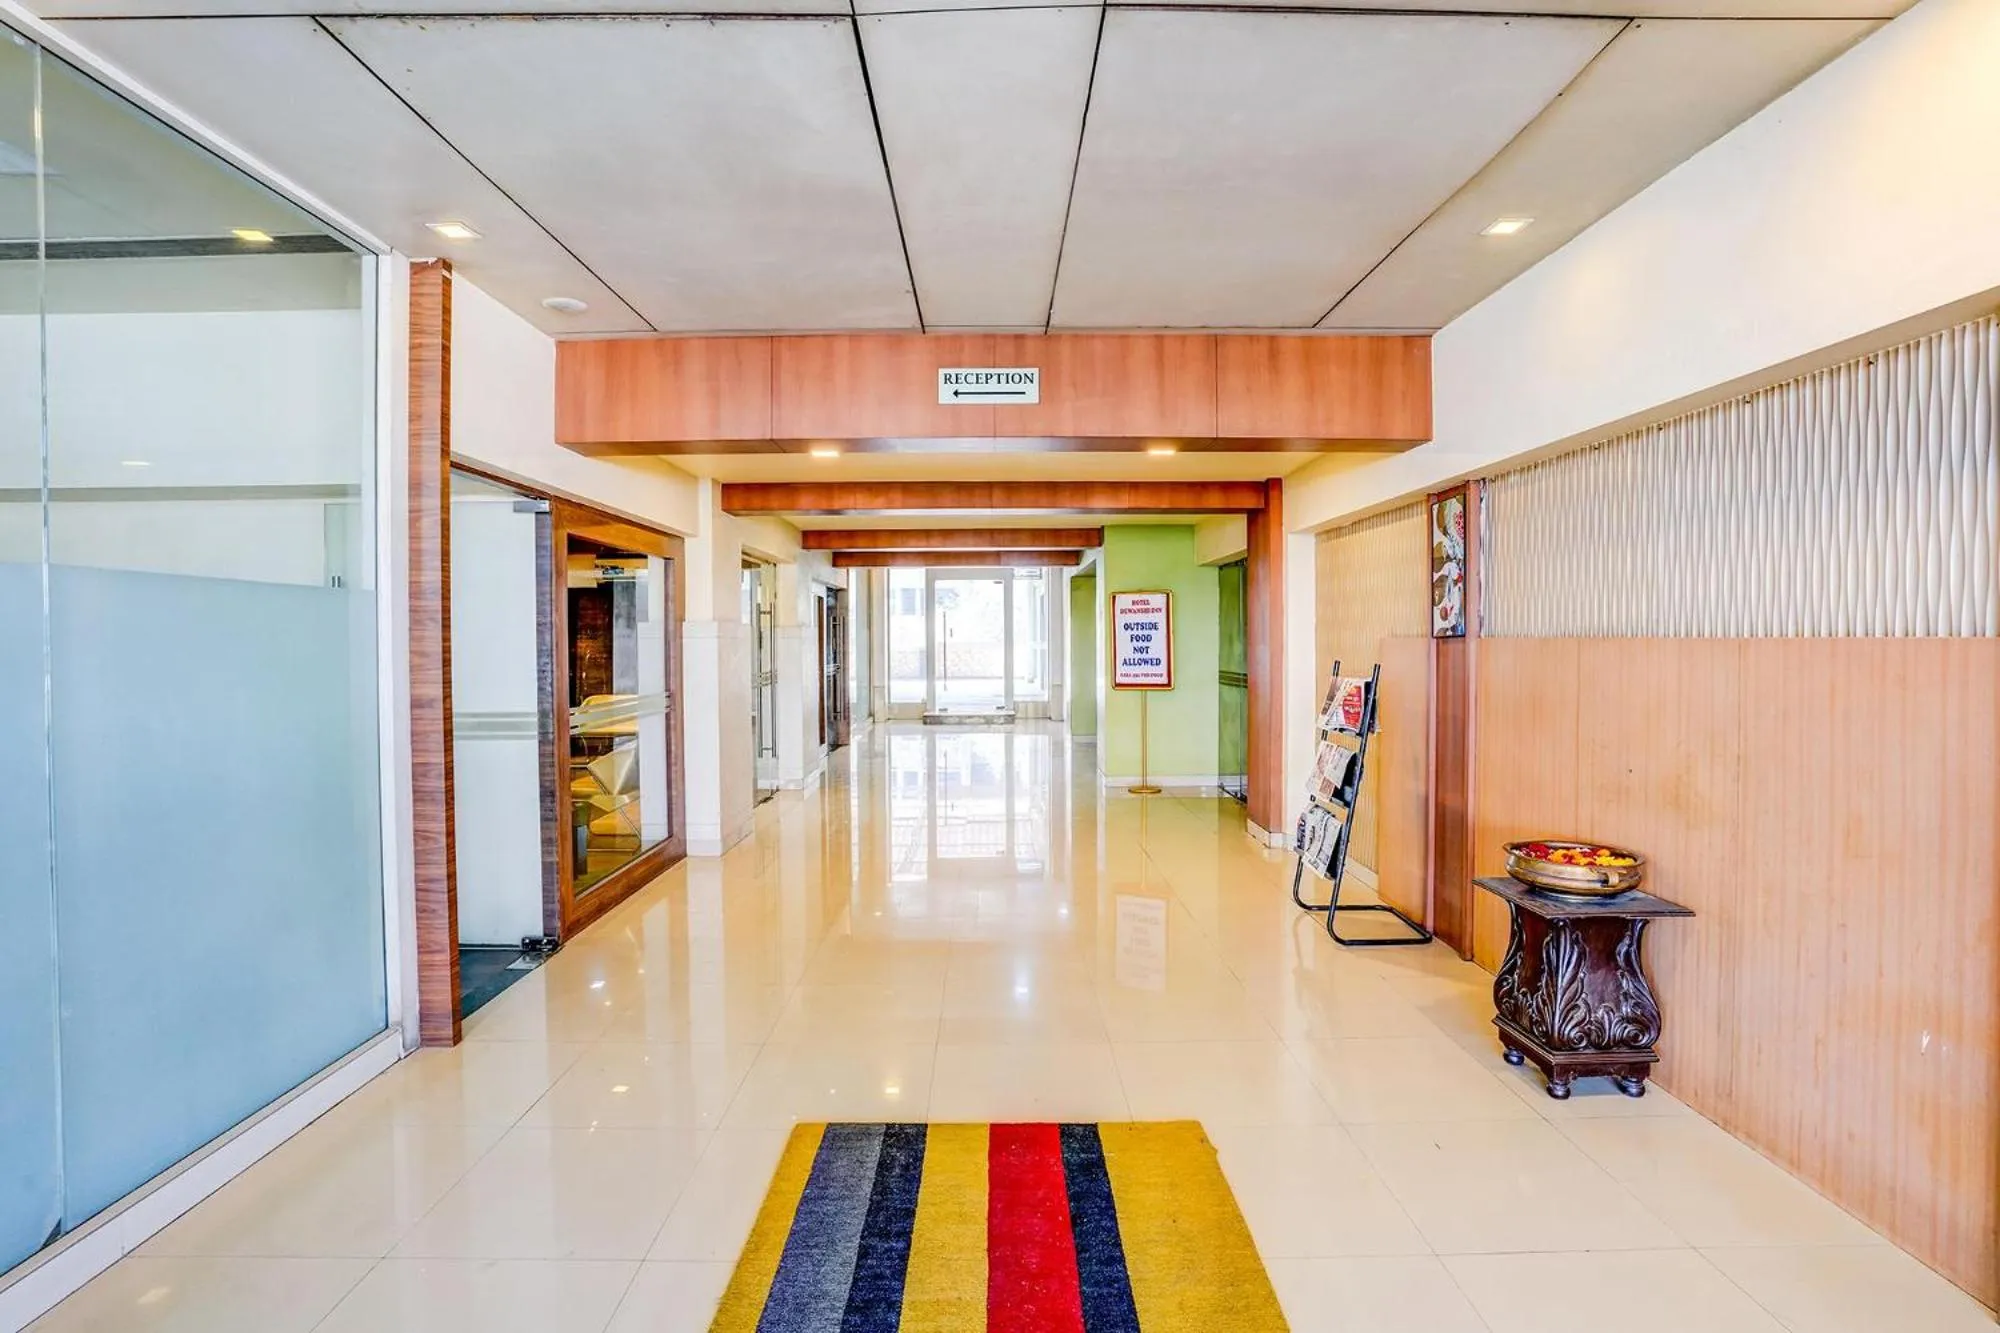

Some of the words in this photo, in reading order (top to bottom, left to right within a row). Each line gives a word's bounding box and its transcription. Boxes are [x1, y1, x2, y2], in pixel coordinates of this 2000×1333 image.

[943, 372, 1035, 385] RECEPTION
[1123, 622, 1160, 631] OUTSIDE
[1130, 634, 1153, 643] FOOD
[1132, 646, 1150, 654] NOT
[1122, 658, 1162, 667] ALLOWED
